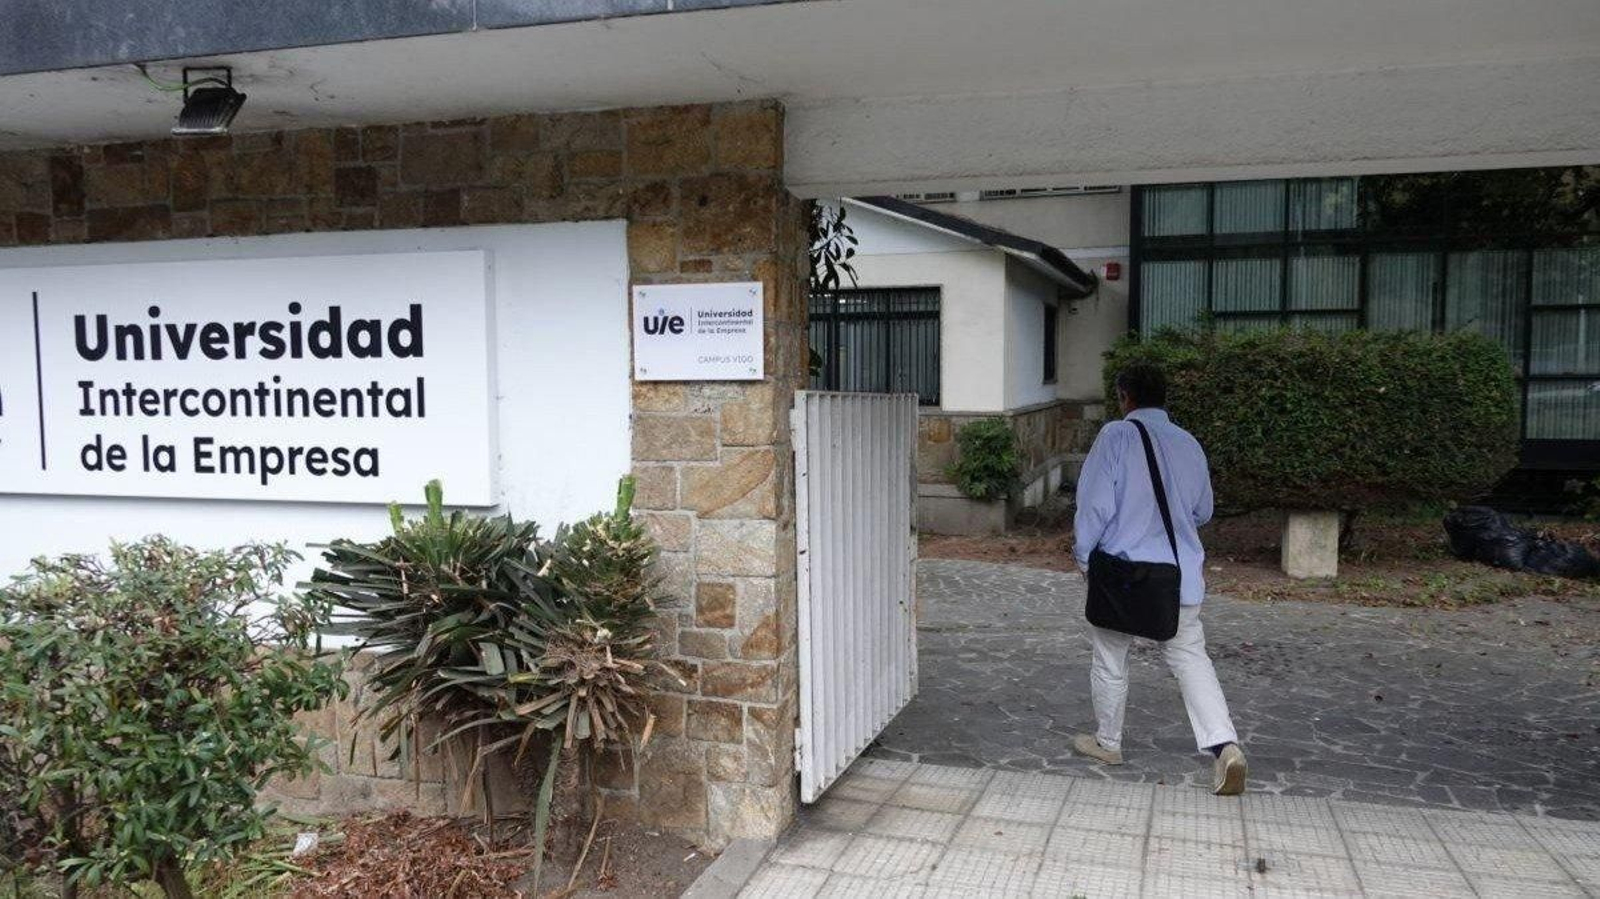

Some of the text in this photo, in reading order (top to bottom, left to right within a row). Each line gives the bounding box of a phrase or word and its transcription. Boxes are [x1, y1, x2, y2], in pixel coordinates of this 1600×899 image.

[74, 301, 424, 362] Universidad
[697, 308, 753, 318] Universidad
[698, 355, 754, 364] CAMPUS VIGO
[77, 375, 426, 418] Intercontinental
[80, 433, 380, 486] de la Empresa
